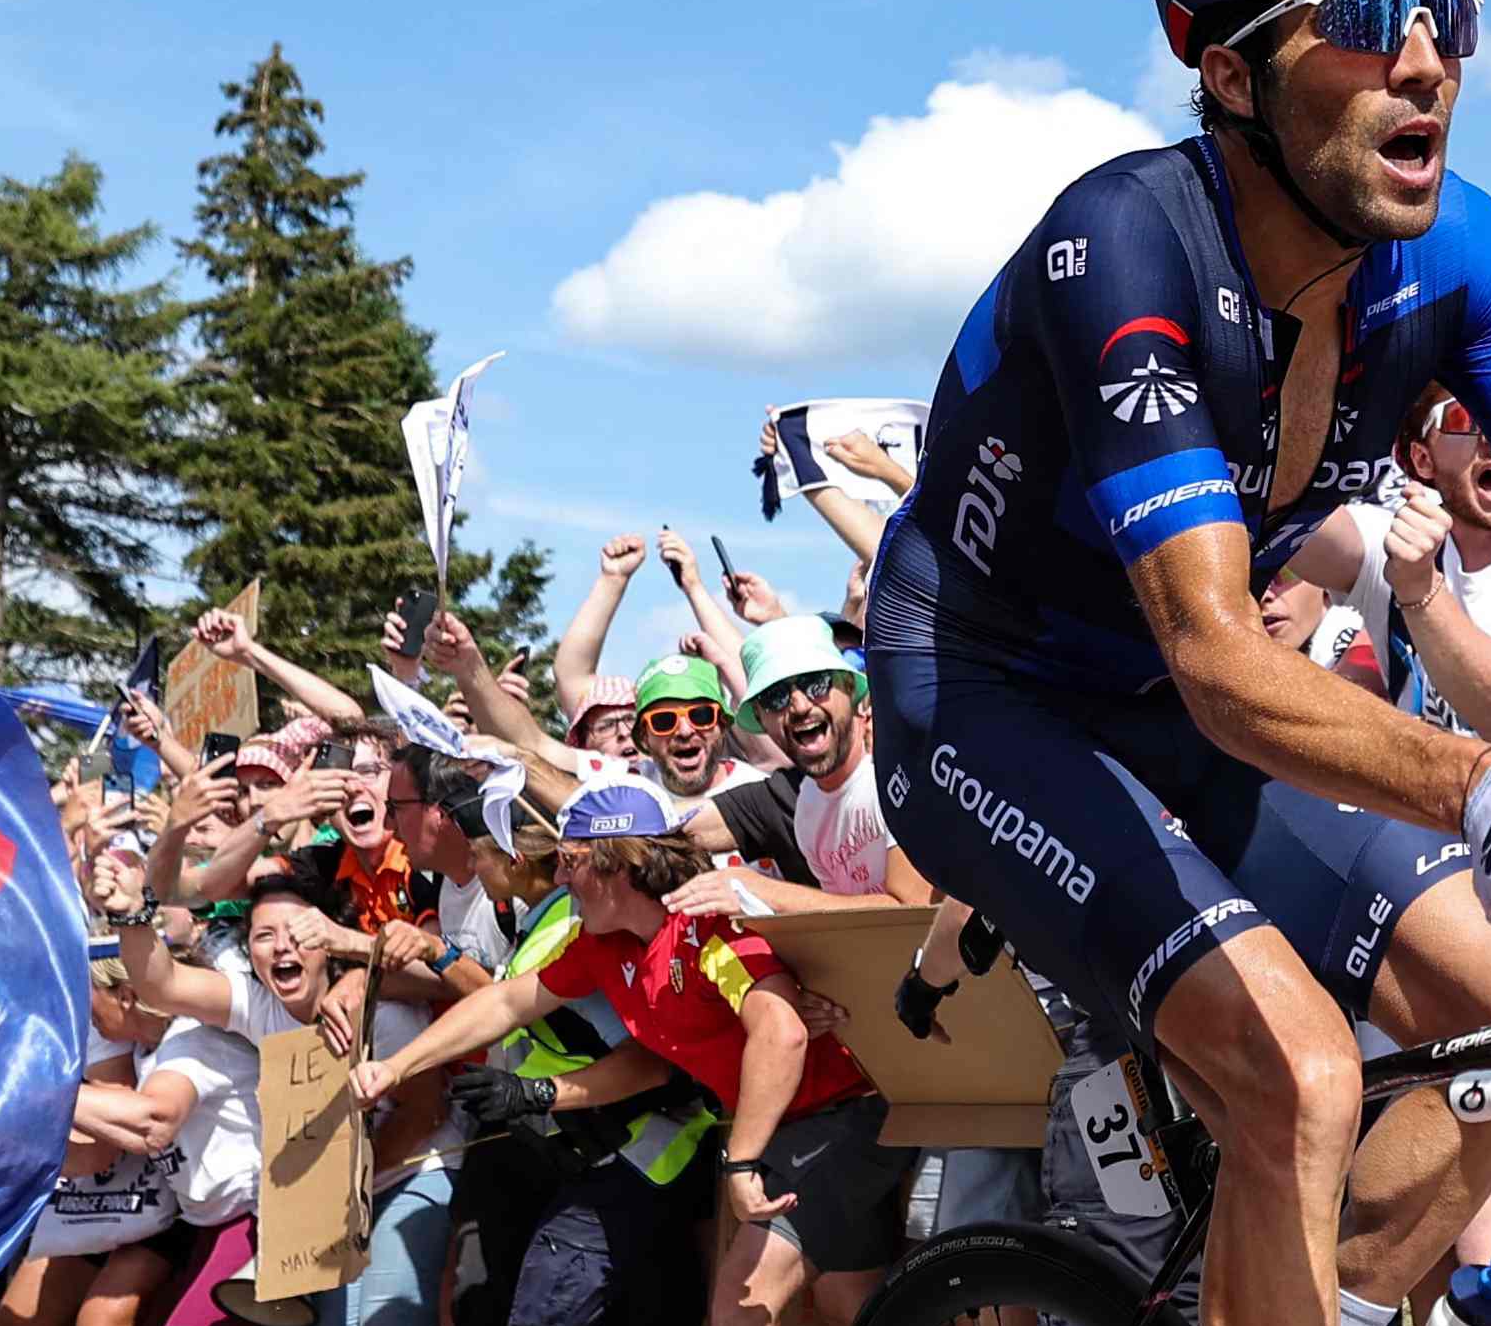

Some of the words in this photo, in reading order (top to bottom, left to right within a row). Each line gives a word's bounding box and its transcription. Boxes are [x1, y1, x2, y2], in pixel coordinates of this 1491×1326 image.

[952, 464, 1007, 576] FDJ
[594, 818, 617, 831] FDJ
[930, 743, 1096, 906] Groupama
[1126, 897, 1259, 1033] LAPIERRE
[288, 1047, 327, 1087] LE
[285, 1108, 319, 1142] LE
[1086, 1103, 1142, 1170] 37
